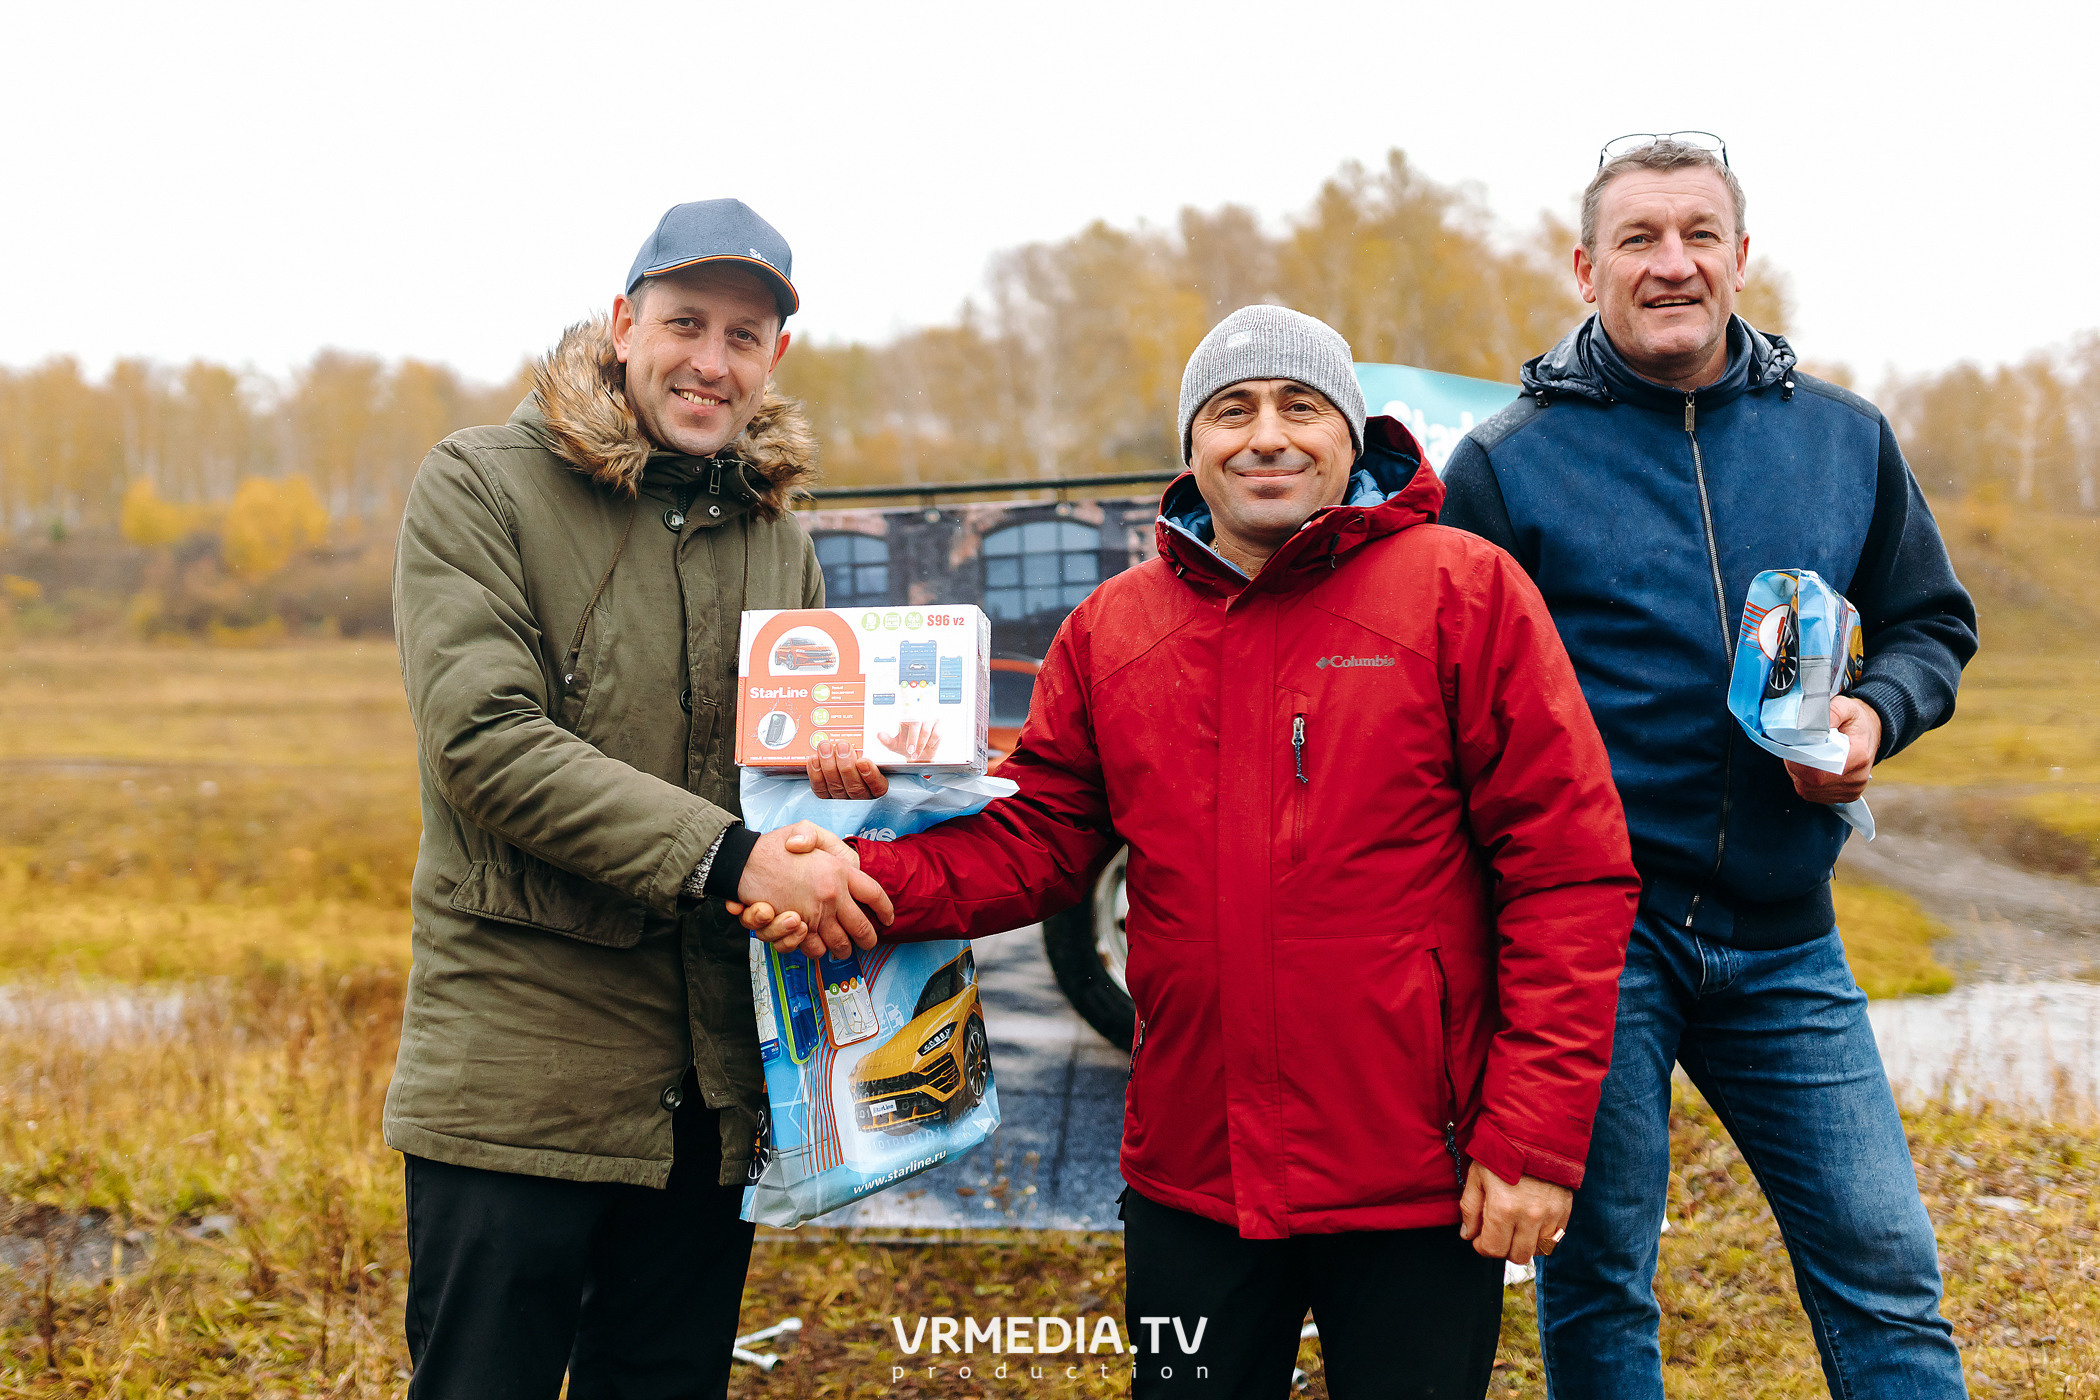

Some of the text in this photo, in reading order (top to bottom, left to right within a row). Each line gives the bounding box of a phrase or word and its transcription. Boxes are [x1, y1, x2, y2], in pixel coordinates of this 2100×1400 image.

[927, 614, 949, 626] S96
[1330, 655, 1395, 668] Columbia
[749, 686, 808, 699] StarLine
[853, 1150, 947, 1194] www.starline.ru
